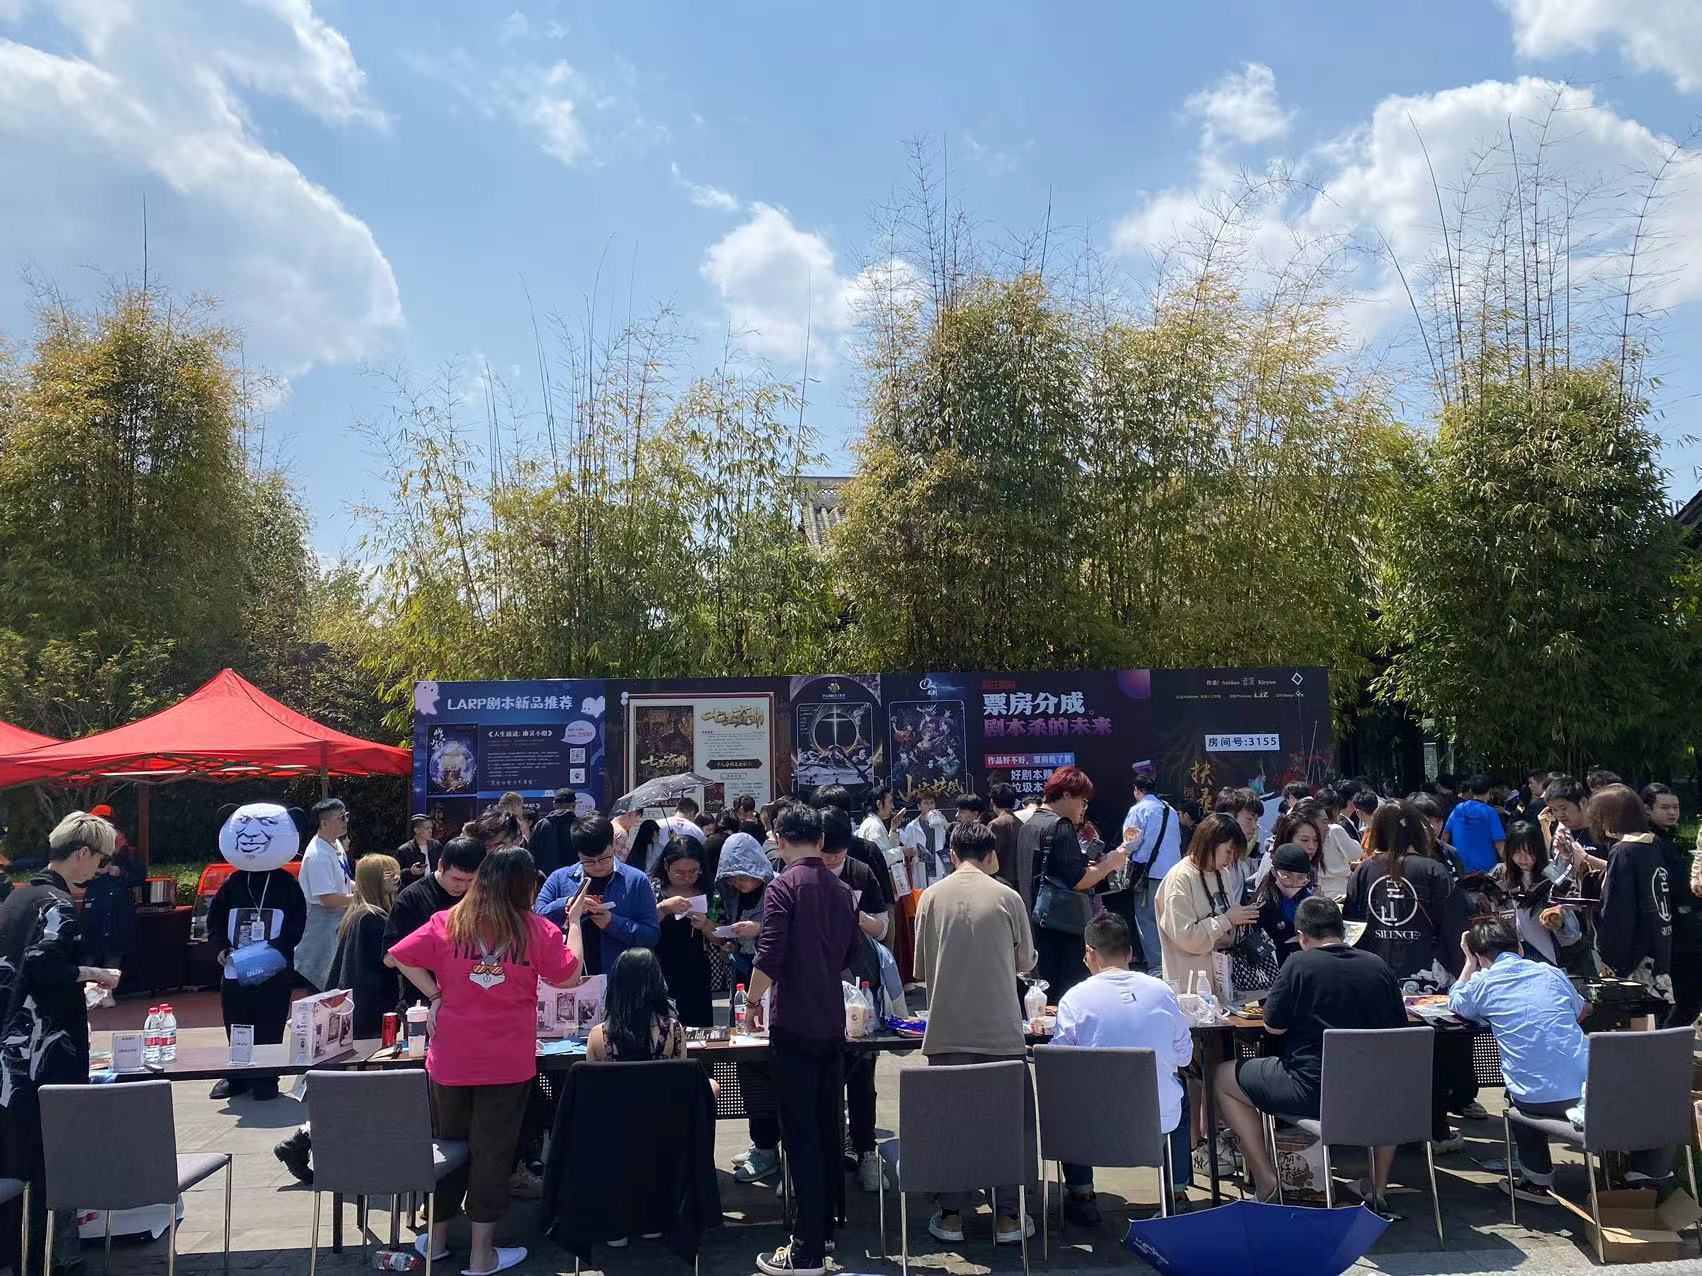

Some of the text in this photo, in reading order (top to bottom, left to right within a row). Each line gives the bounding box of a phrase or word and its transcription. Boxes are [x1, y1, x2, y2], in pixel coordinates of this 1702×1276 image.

[447, 695, 573, 710] LARP剧本新品推荐
[983, 716, 1113, 737] 剧本杀的未来
[1207, 737, 1277, 748] 房间号:3155
[1374, 929, 1419, 940] SILENCE
